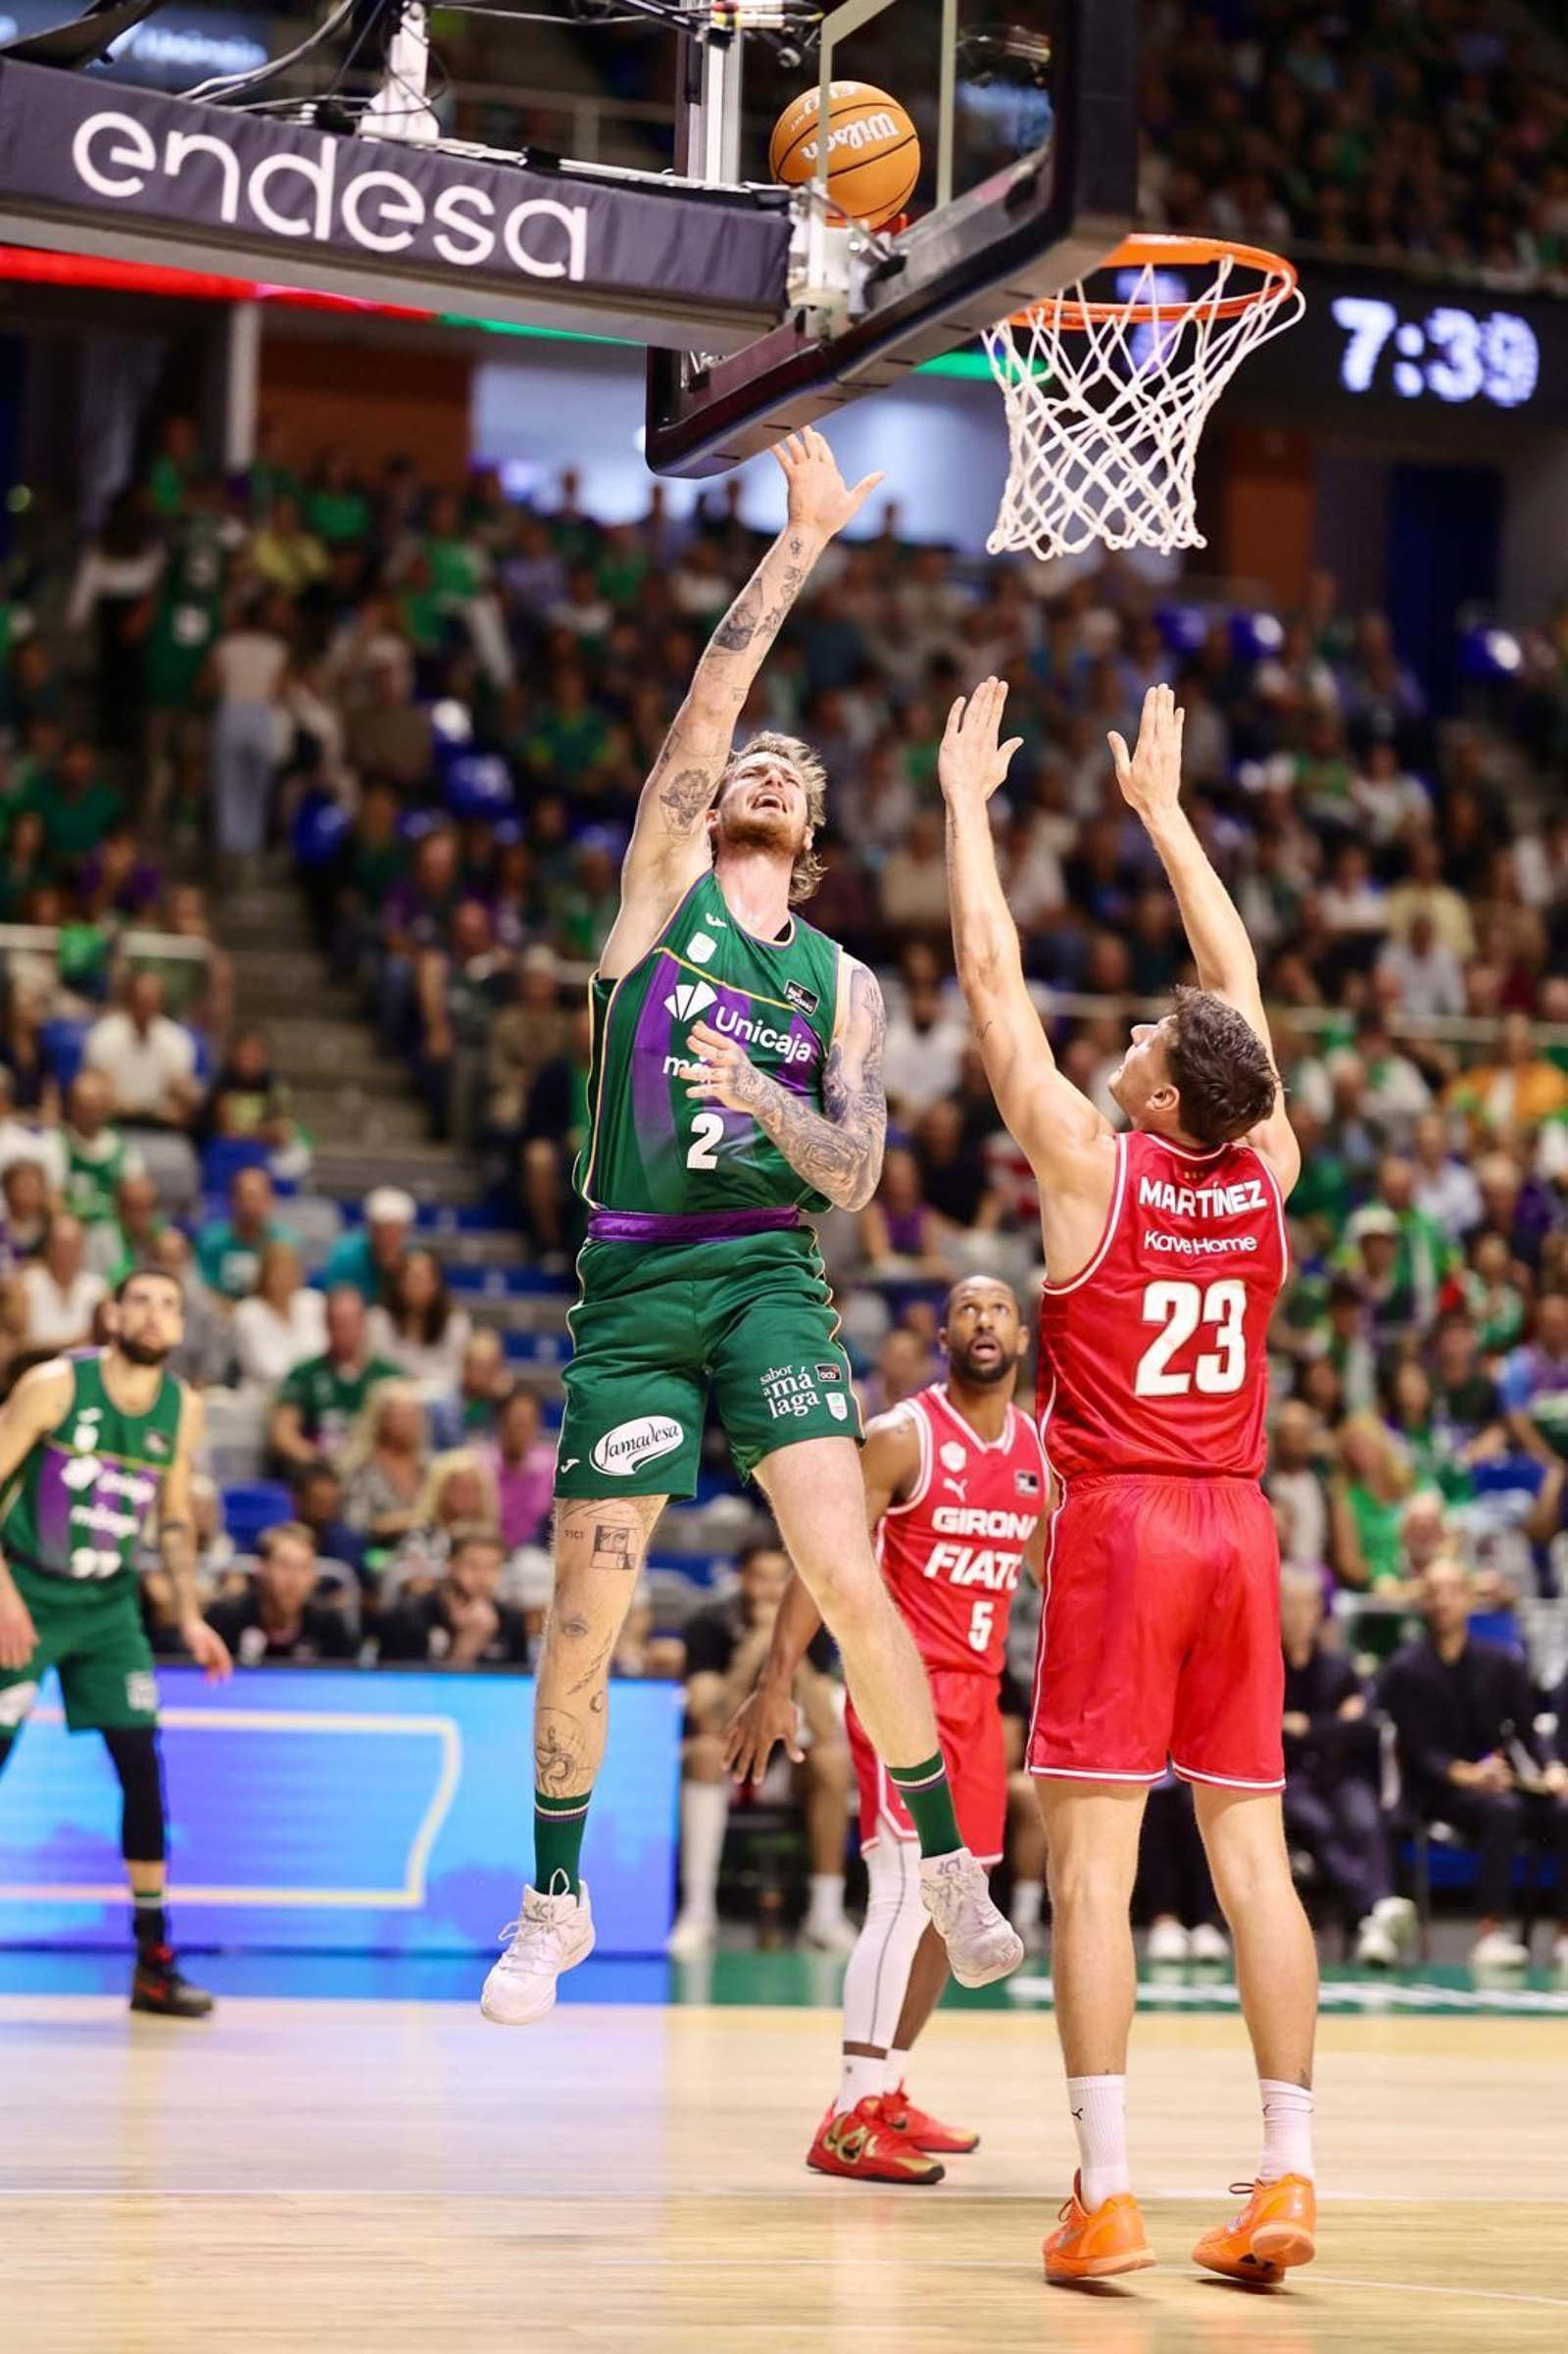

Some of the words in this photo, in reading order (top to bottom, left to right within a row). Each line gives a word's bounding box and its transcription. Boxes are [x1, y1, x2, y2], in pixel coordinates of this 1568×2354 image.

[73, 111, 588, 282] endesa
[1331, 296, 1540, 408] 7:39
[715, 1005, 811, 1062] Unicaja
[687, 1112, 724, 1170] 2
[1139, 1176, 1268, 1218] MARTÍNEZ
[1134, 1279, 1248, 1398] 23
[760, 1364, 793, 1386] sabor
[766, 1391, 821, 1420] laga
[968, 1599, 994, 1651] 5
